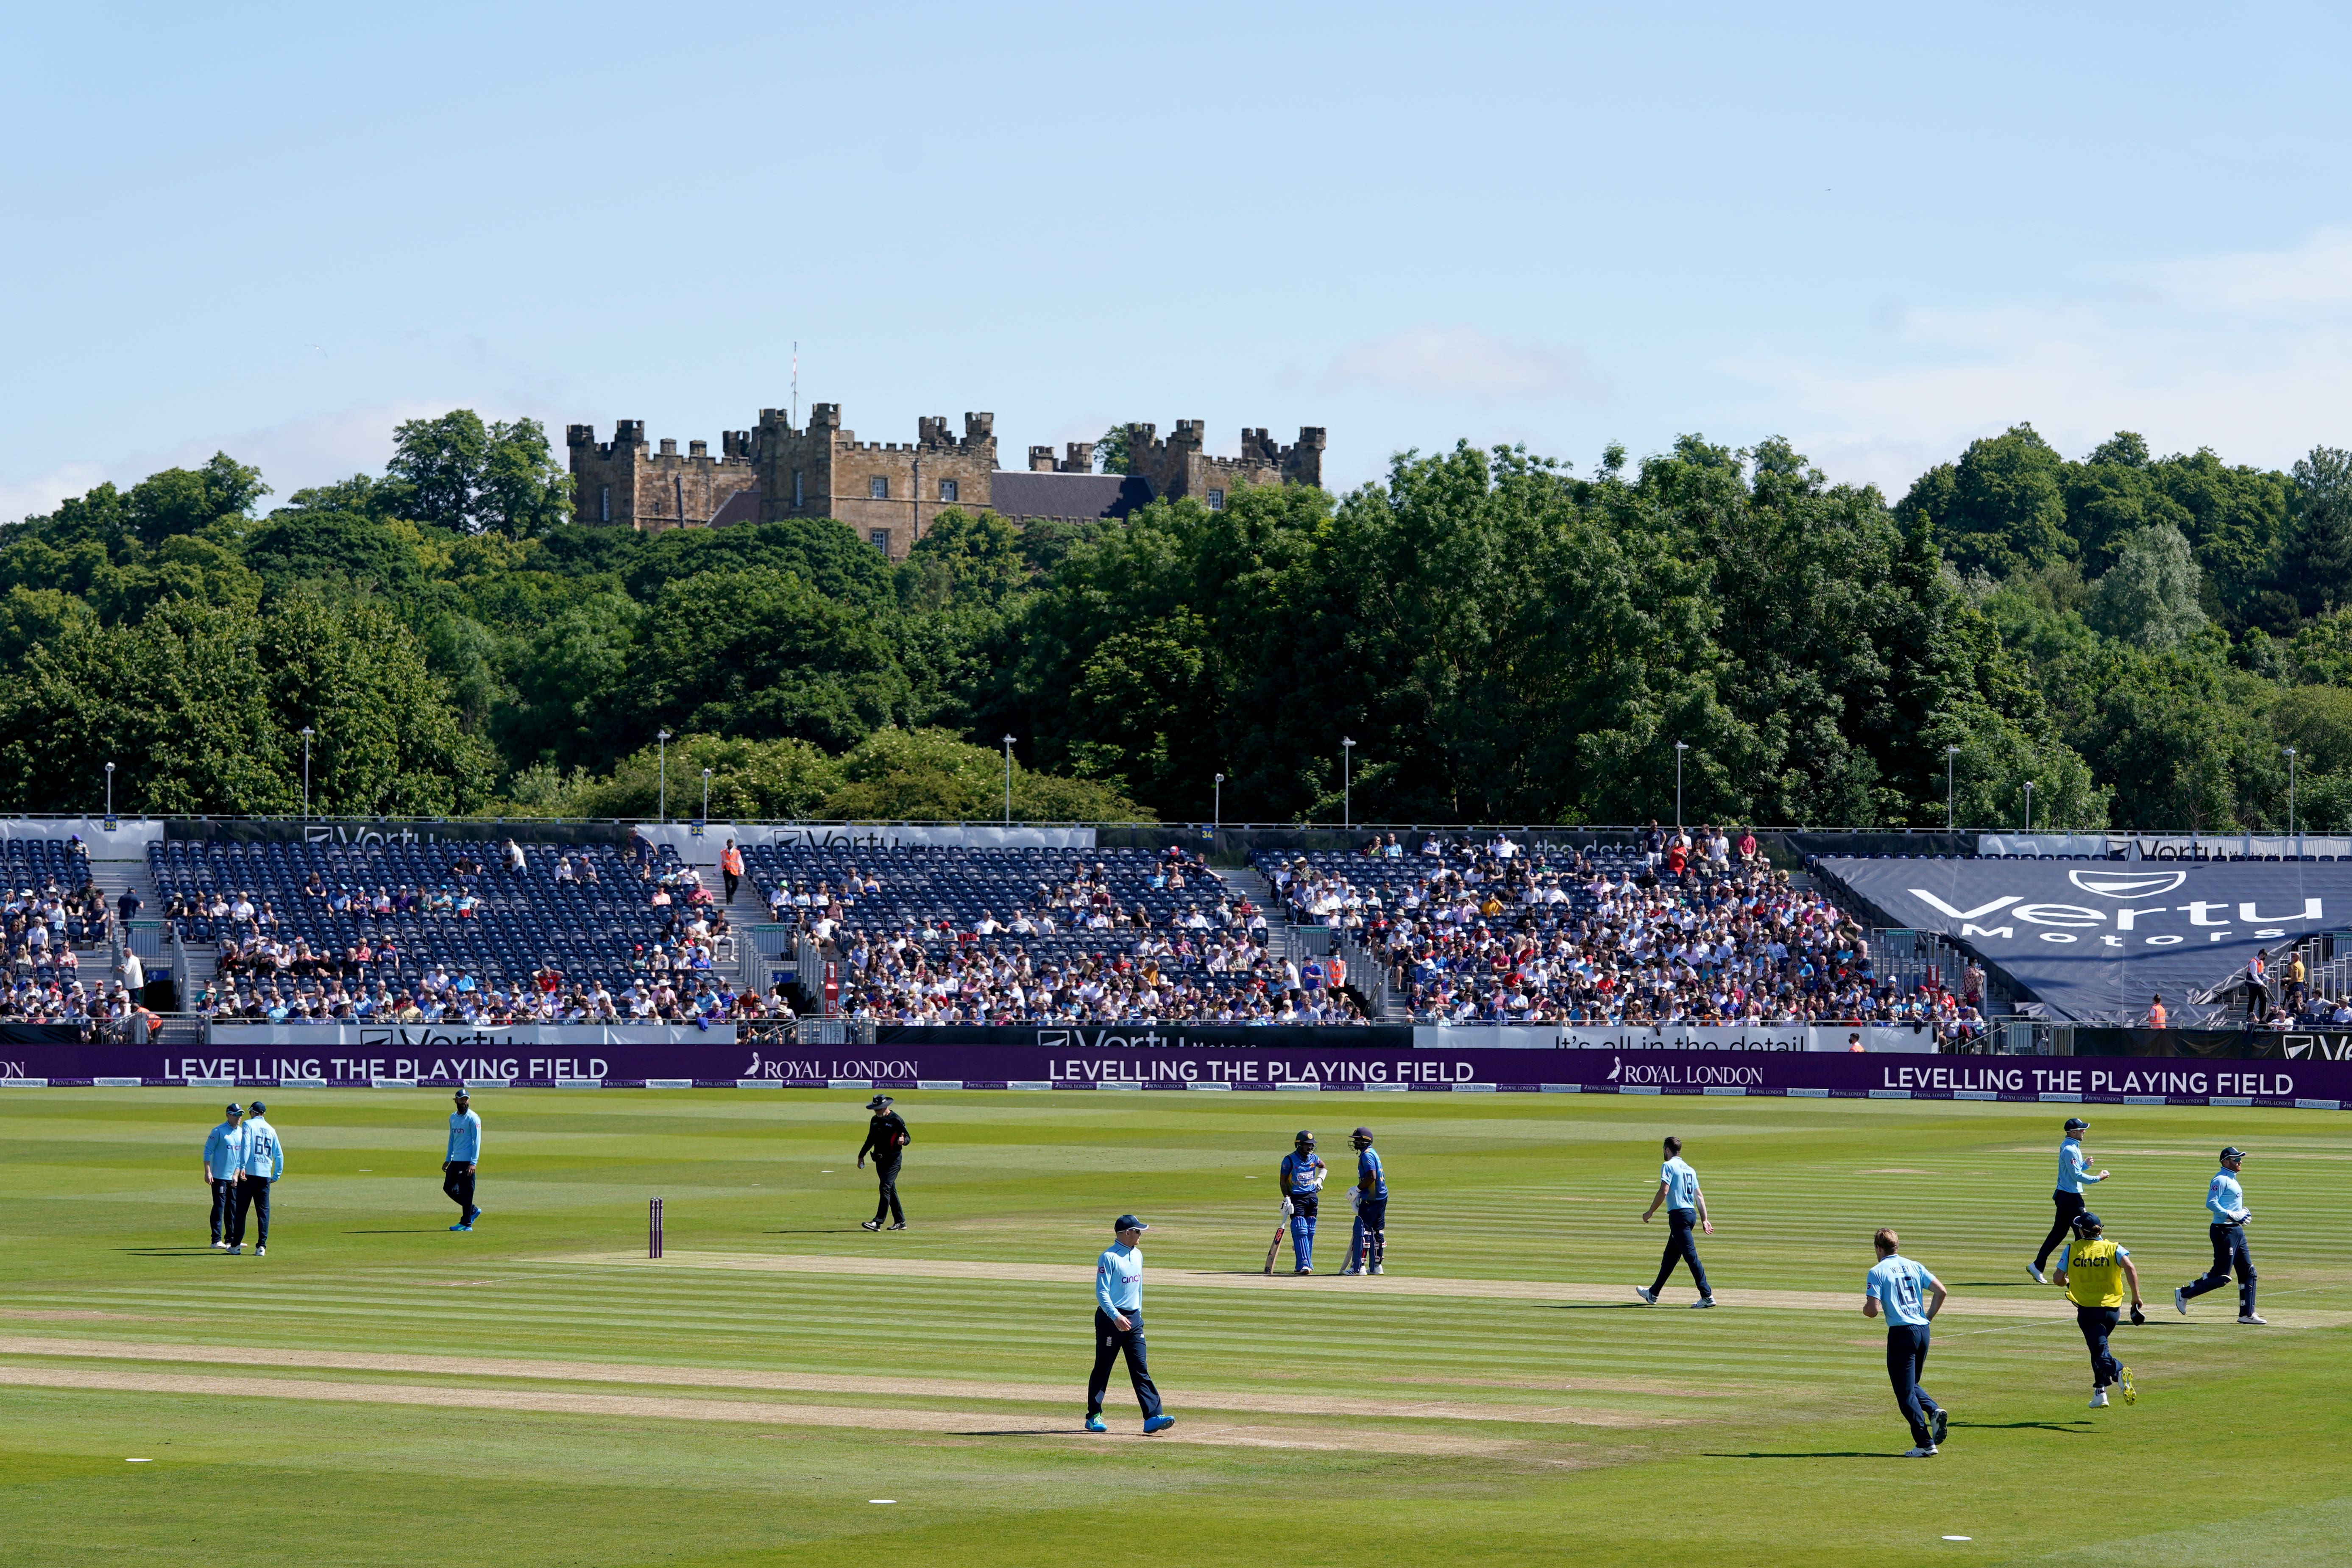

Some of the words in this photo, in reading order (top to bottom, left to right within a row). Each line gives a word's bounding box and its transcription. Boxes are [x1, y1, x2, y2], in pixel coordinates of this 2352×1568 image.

[105, 821, 116, 830] 32
[692, 826, 702, 834] 33
[1202, 830, 1213, 838] 34
[1907, 889, 2322, 930] Vertu
[1962, 924, 2286, 947] Motors
[165, 1059, 320, 1079] LEVELLING
[331, 1059, 385, 1079] THE
[396, 1059, 519, 1079] PLAYING
[529, 1059, 608, 1079] FIELD
[764, 1061, 827, 1078] ROYAL
[832, 1061, 917, 1078] LONDON
[1050, 1060, 1198, 1081] LEVELLING
[1207, 1061, 1259, 1081] THE
[1268, 1061, 1386, 1081] PLAYING
[1397, 1062, 1474, 1082] FIELD
[1625, 1065, 1681, 1083] ROYAL
[1686, 1066, 1763, 1084] LONDON
[1884, 1067, 2023, 1090] LEVELLING
[2032, 1070, 2082, 1091] THE
[2092, 1071, 2207, 1093] PLAYING
[2218, 1073, 2293, 1095] FIELD
[255, 1136, 271, 1157] 65
[1889, 1265, 1910, 1273] WILLEY
[2073, 1254, 2110, 1267] cinch
[1895, 1276, 1917, 1306] 15
